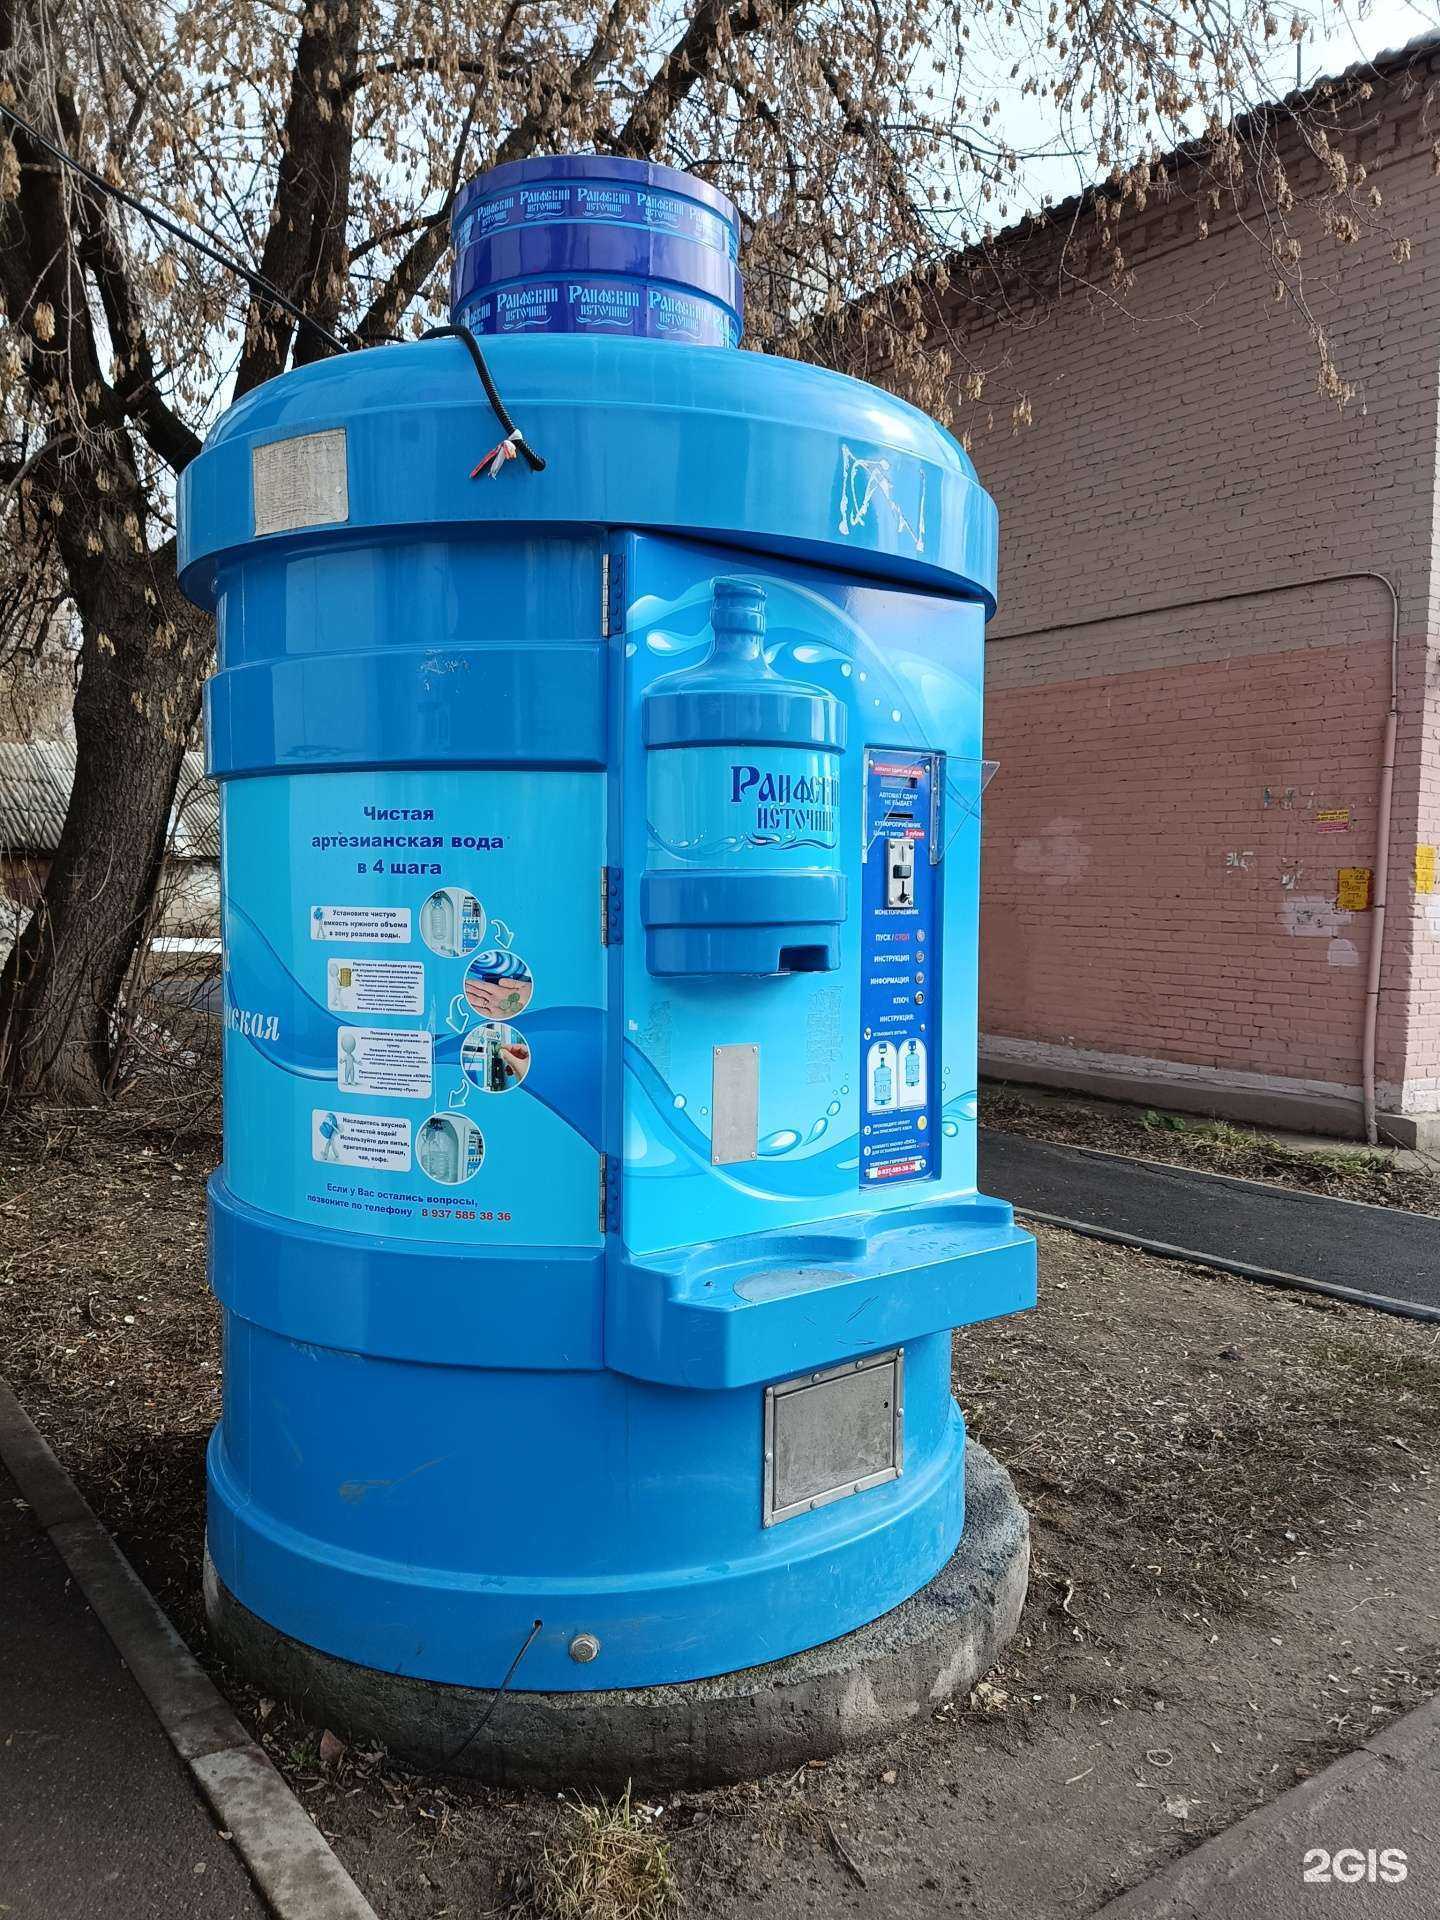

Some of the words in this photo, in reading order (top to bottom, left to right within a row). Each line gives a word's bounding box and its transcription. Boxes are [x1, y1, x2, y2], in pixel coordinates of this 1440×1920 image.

[363, 806, 434, 821] Чистая
[311, 836, 443, 851] артезианская
[451, 837, 504, 851] вода
[357, 863, 367, 874] в
[372, 859, 385, 874] 4
[390, 863, 442, 875] шага
[332, 909, 369, 917] Установите
[371, 911, 396, 919] чистую
[874, 955, 910, 963] ИНСТРУКЦИЯ
[870, 977, 910, 985] ИНФОРМАЦИЯ
[381, 1121, 407, 1129] вкусной
[343, 1144, 386, 1154] приготовления
[327, 1183, 348, 1193] Если
[350, 1187, 356, 1196] у
[357, 1187, 375, 1197] Вас
[377, 1191, 424, 1203] остались
[427, 1196, 478, 1208] вопросы,
[307, 1194, 349, 1208] позвоните
[351, 1202, 362, 1210] по
[364, 1203, 413, 1217] телефону
[421, 1208, 428, 1217] 8
[431, 1209, 451, 1219] 937
[455, 1211, 476, 1220] 585
[479, 1211, 493, 1221] 38
[497, 1212, 511, 1221] 36
